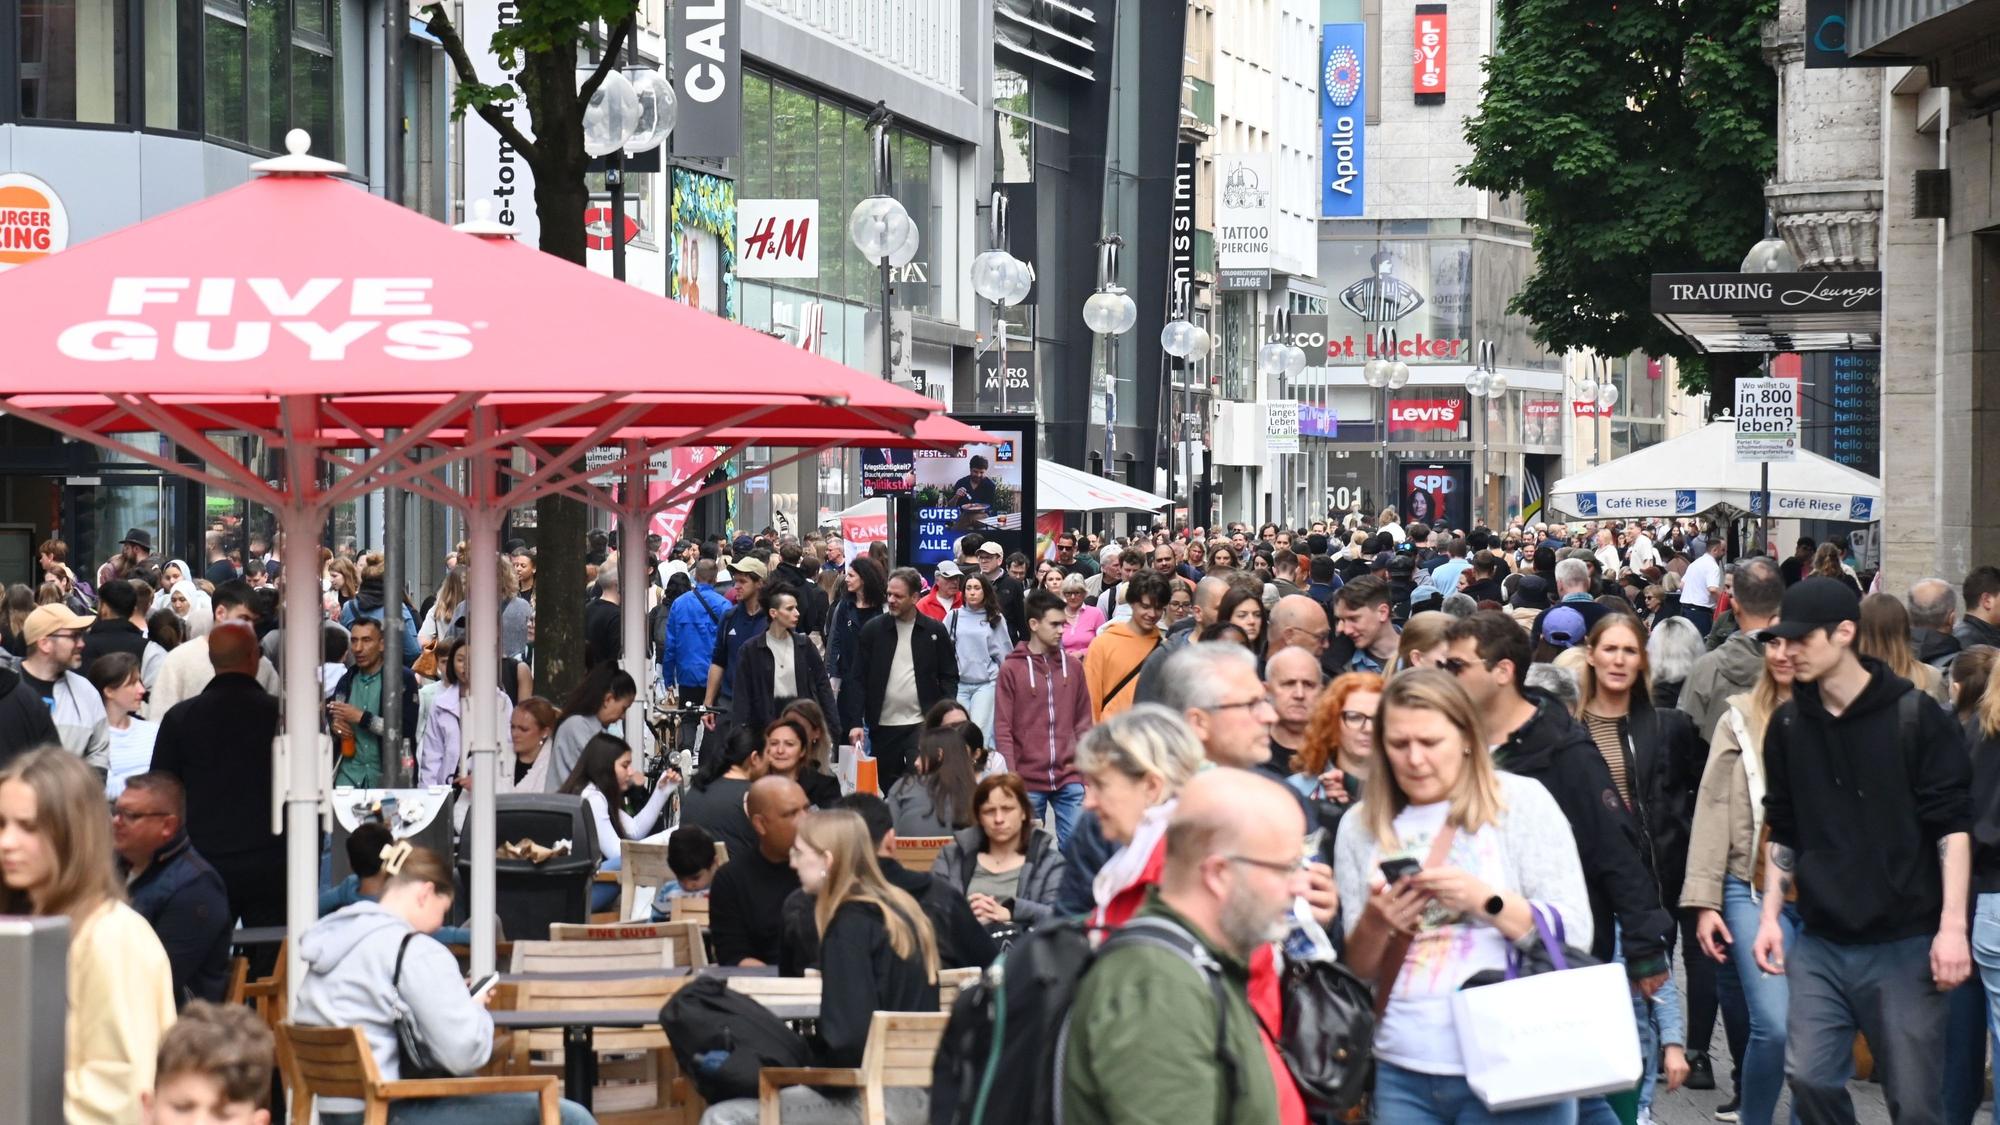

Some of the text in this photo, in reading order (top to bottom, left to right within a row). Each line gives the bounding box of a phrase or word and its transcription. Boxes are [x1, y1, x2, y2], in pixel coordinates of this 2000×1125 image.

[1332, 117, 1358, 195] Apollo
[0, 211, 50, 227] URGER
[1221, 226, 1268, 239] TATTOO
[0, 227, 50, 250] ING
[745, 217, 809, 261] H&M
[1221, 242, 1268, 253] PIERCING
[1229, 277, 1262, 288] 1.ETAGE
[107, 277, 433, 316] FIVE
[1670, 275, 1881, 308] TRAURING Lounge
[57, 319, 474, 362] GUYS
[1835, 356, 1863, 366] hello
[987, 367, 1028, 378] VRO
[1835, 370, 1863, 380] hello
[1835, 384, 1863, 394] hello
[1740, 390, 1792, 404] in 800
[1834, 398, 1863, 408] hello
[1269, 408, 1296, 418] langes
[1737, 403, 1793, 417] Jahren
[1834, 412, 1862, 422] hello
[1267, 426, 1297, 434] für alle
[1737, 418, 1793, 432] leben?
[1834, 426, 1862, 436] hello
[1834, 440, 1862, 450] hello
[1413, 475, 1457, 494] SPD
[1327, 486, 1361, 511] 501
[1606, 498, 1632, 508] Café
[1636, 498, 1667, 508] Riese
[1779, 498, 1806, 509] Café
[1810, 500, 1842, 511] Riese
[920, 509, 958, 520] GUTES
[920, 522, 944, 535] FÜR
[919, 540, 951, 550] ALLE.
[896, 839, 917, 848] FIVE
[588, 927, 656, 938] FIVE GUYS
